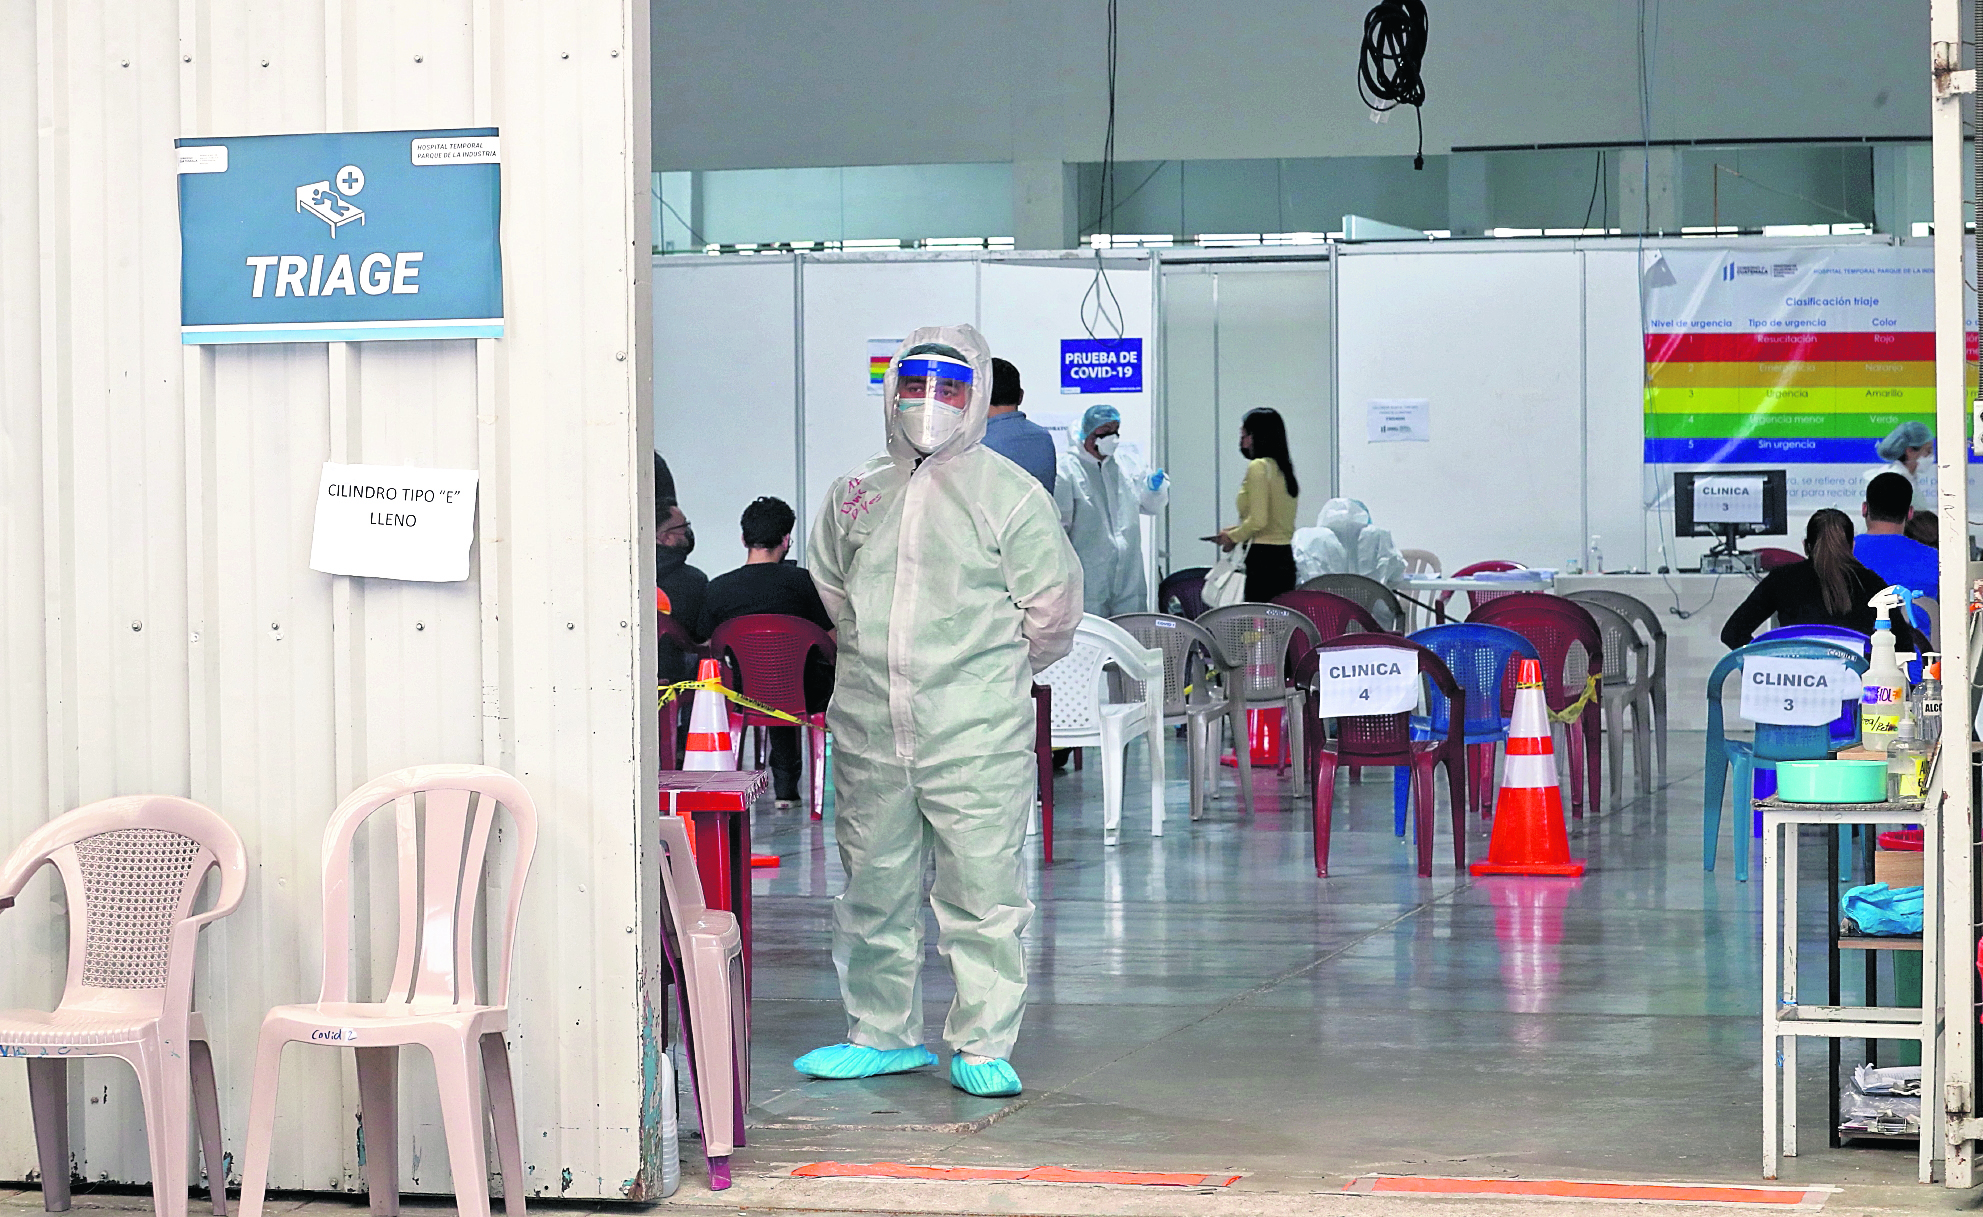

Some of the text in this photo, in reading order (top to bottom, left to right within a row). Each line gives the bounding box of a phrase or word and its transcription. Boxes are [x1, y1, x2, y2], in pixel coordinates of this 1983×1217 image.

[417, 142, 484, 151] HOSPITAL TEMPORAL
[246, 251, 424, 298] TRIAGE
[1785, 296, 1880, 308] Clasificación triaje
[1651, 319, 1732, 329] Nivel de urgencia
[1748, 318, 1827, 329] Tipo de urgencia
[1871, 317, 1897, 327] Color
[1757, 334, 1818, 343] Resucitación
[1874, 333, 1895, 345] Rojo
[1065, 350, 1138, 365] PRUEBA DE
[1070, 366, 1133, 379] COVID-19
[1688, 389, 1694, 398] 3
[1766, 389, 1809, 400] Urgencia
[1865, 388, 1904, 398] Amarillo
[1794, 414, 1825, 424] menor
[1869, 414, 1900, 424] Verde
[1688, 439, 1694, 449] 5
[1758, 438, 1816, 452] Sin urgencia
[328, 483, 397, 501] CILINDRO
[402, 487, 435, 503] TIPO
[1702, 486, 1750, 496] CLINICA
[1722, 502, 1729, 512] 3
[370, 511, 417, 528] LLENO
[1329, 662, 1402, 679] CLINICA
[1752, 671, 1829, 688] CLINICA
[1358, 688, 1370, 701] 4
[1783, 698, 1795, 712] 3
[311, 1028, 358, 1041] Covid 2
